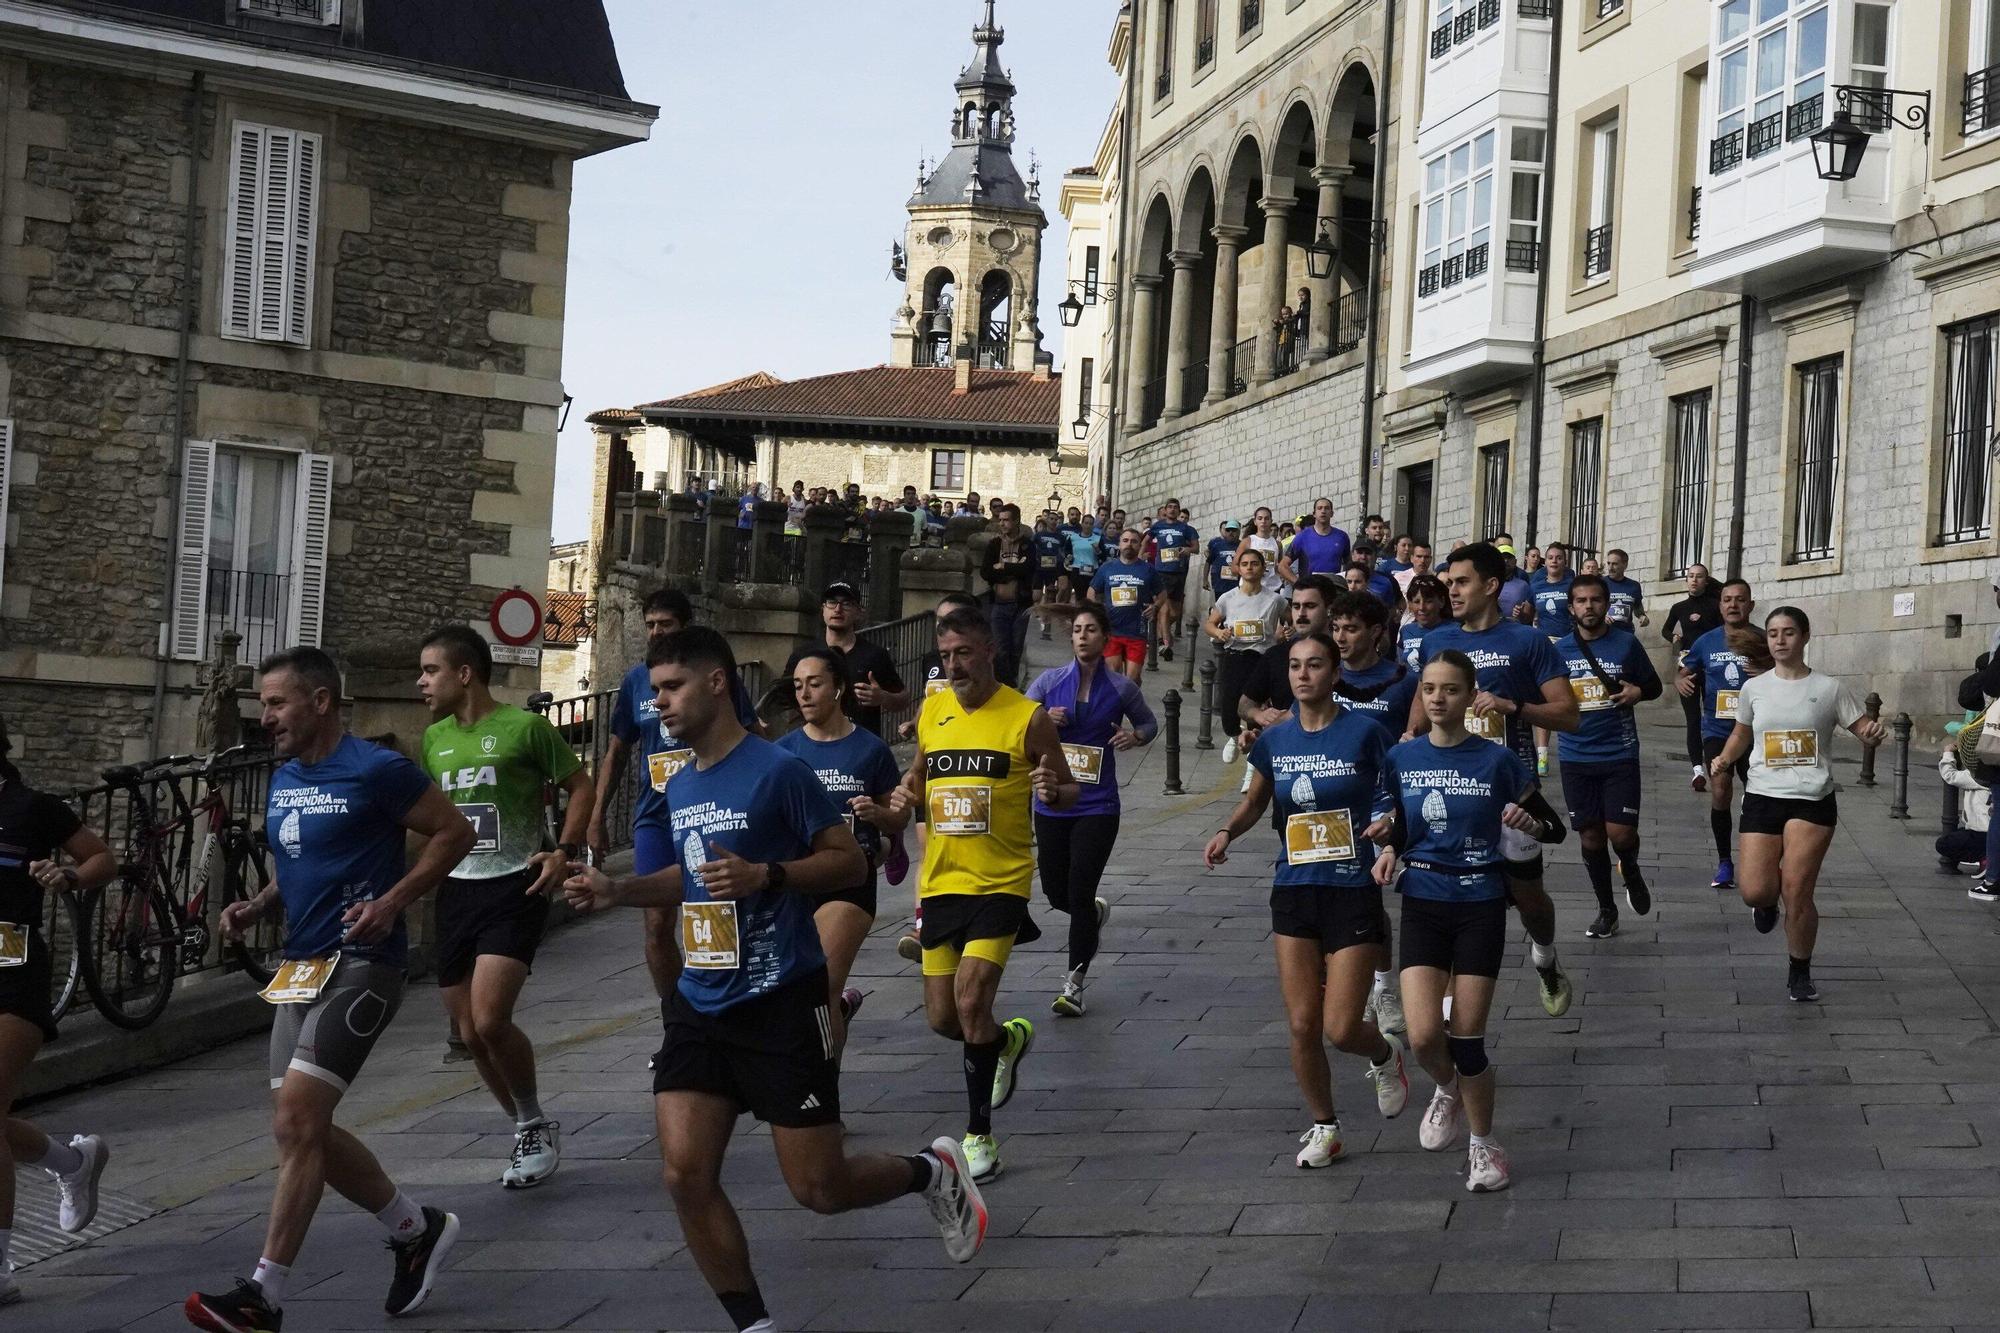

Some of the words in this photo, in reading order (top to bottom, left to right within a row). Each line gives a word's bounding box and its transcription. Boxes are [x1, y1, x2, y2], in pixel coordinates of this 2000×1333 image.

[1583, 685, 1604, 699] 514
[1463, 717, 1489, 733] 591
[1779, 739, 1803, 754] 161
[927, 754, 996, 773] POINT
[1065, 751, 1089, 769] 643
[1281, 754, 1327, 764] CONQUISTA
[1281, 759, 1345, 773] ALMENDRA
[441, 766, 498, 792] LEA
[1312, 768, 1358, 779] KONKISTA
[1400, 771, 1409, 779] LA
[1408, 769, 1460, 779] CONQUISTA
[826, 783, 865, 792] KONKISTA
[1410, 777, 1479, 788] ALMENDRA
[280, 786, 320, 797] CONQUISTA
[1444, 787, 1492, 797] KONKISTA
[275, 792, 333, 808] ALMENDRA
[943, 797, 973, 817] 576
[301, 804, 349, 815] KONKISTA
[674, 801, 717, 820] CONQUISTA
[673, 807, 733, 832] ALMENDRA
[732, 812, 748, 820] REN
[702, 819, 749, 836] KONKISTA
[1308, 824, 1328, 844] 72
[692, 919, 713, 944] 64
[288, 964, 316, 983] 33
